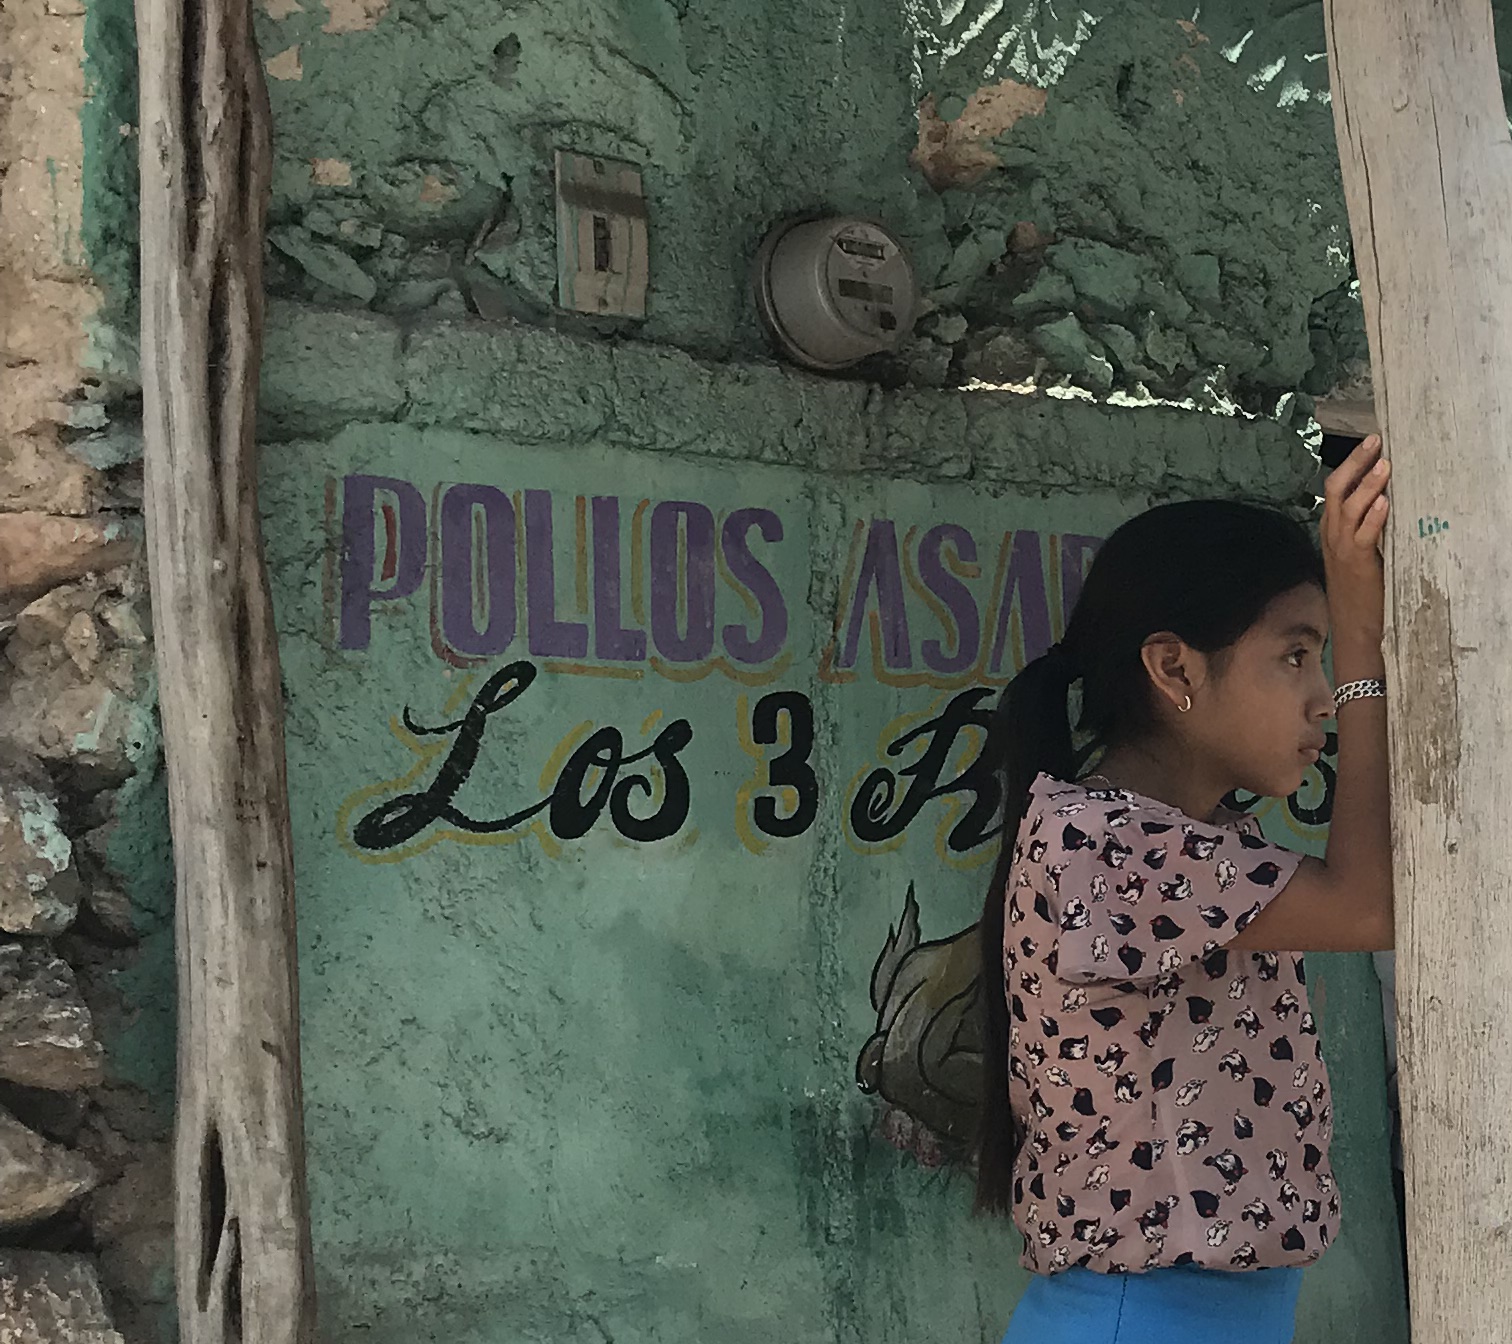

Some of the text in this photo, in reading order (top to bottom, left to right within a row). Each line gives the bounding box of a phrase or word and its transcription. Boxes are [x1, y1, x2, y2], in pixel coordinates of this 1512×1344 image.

[340, 474, 788, 664] POLLOS
[353, 661, 693, 850] Los
[752, 691, 818, 838] 3
